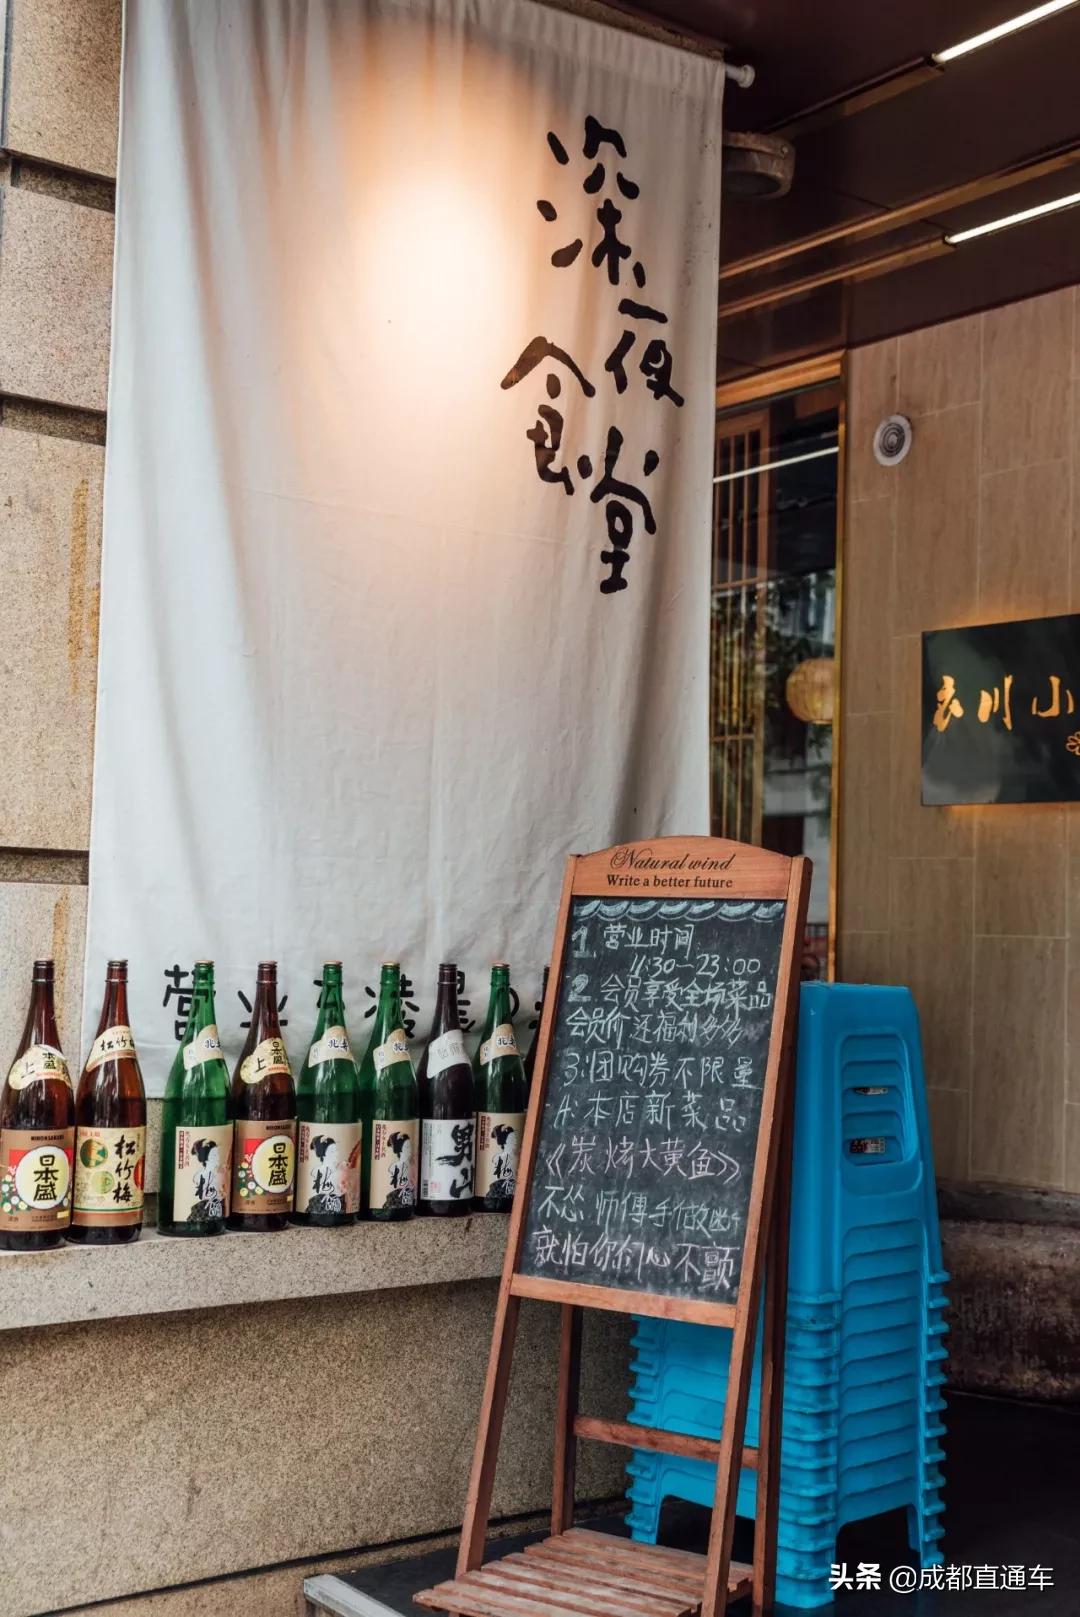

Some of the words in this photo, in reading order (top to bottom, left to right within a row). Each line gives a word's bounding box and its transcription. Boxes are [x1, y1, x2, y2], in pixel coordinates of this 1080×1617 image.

[500, 115, 684, 594] 深夜食堂
[607, 874, 643, 887] Write
[643, 878, 650, 887] a
[653, 875, 691, 888] better
[693, 876, 734, 889] future
[610, 847, 689, 870] Natural
[689, 853, 736, 870] wind
[33, 1154, 60, 1202] 日本盛
[112, 1134, 136, 1204] 松竹梅
[268, 1142, 289, 1187] 日本盛
